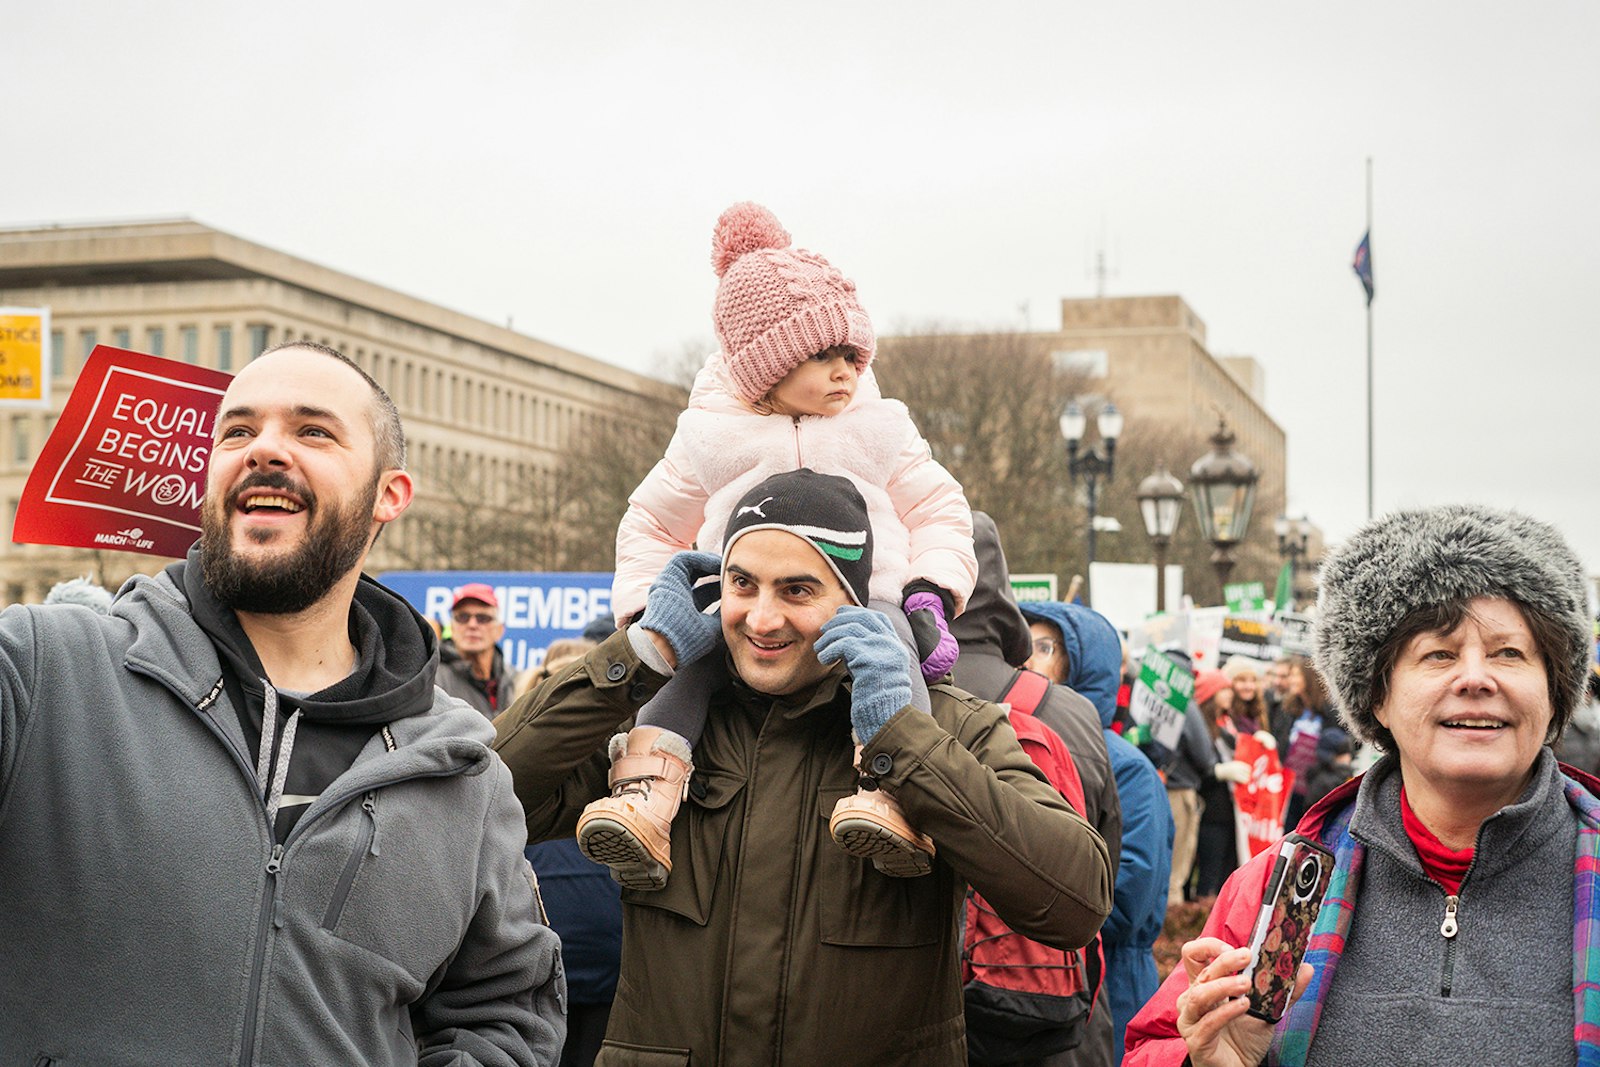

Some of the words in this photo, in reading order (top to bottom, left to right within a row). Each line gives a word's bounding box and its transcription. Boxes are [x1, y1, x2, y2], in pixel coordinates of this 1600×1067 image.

[96, 427, 209, 472] BEGINS
[82, 463, 121, 484] THE
[94, 533, 127, 545] MARCH
[136, 539, 154, 549] LIFE
